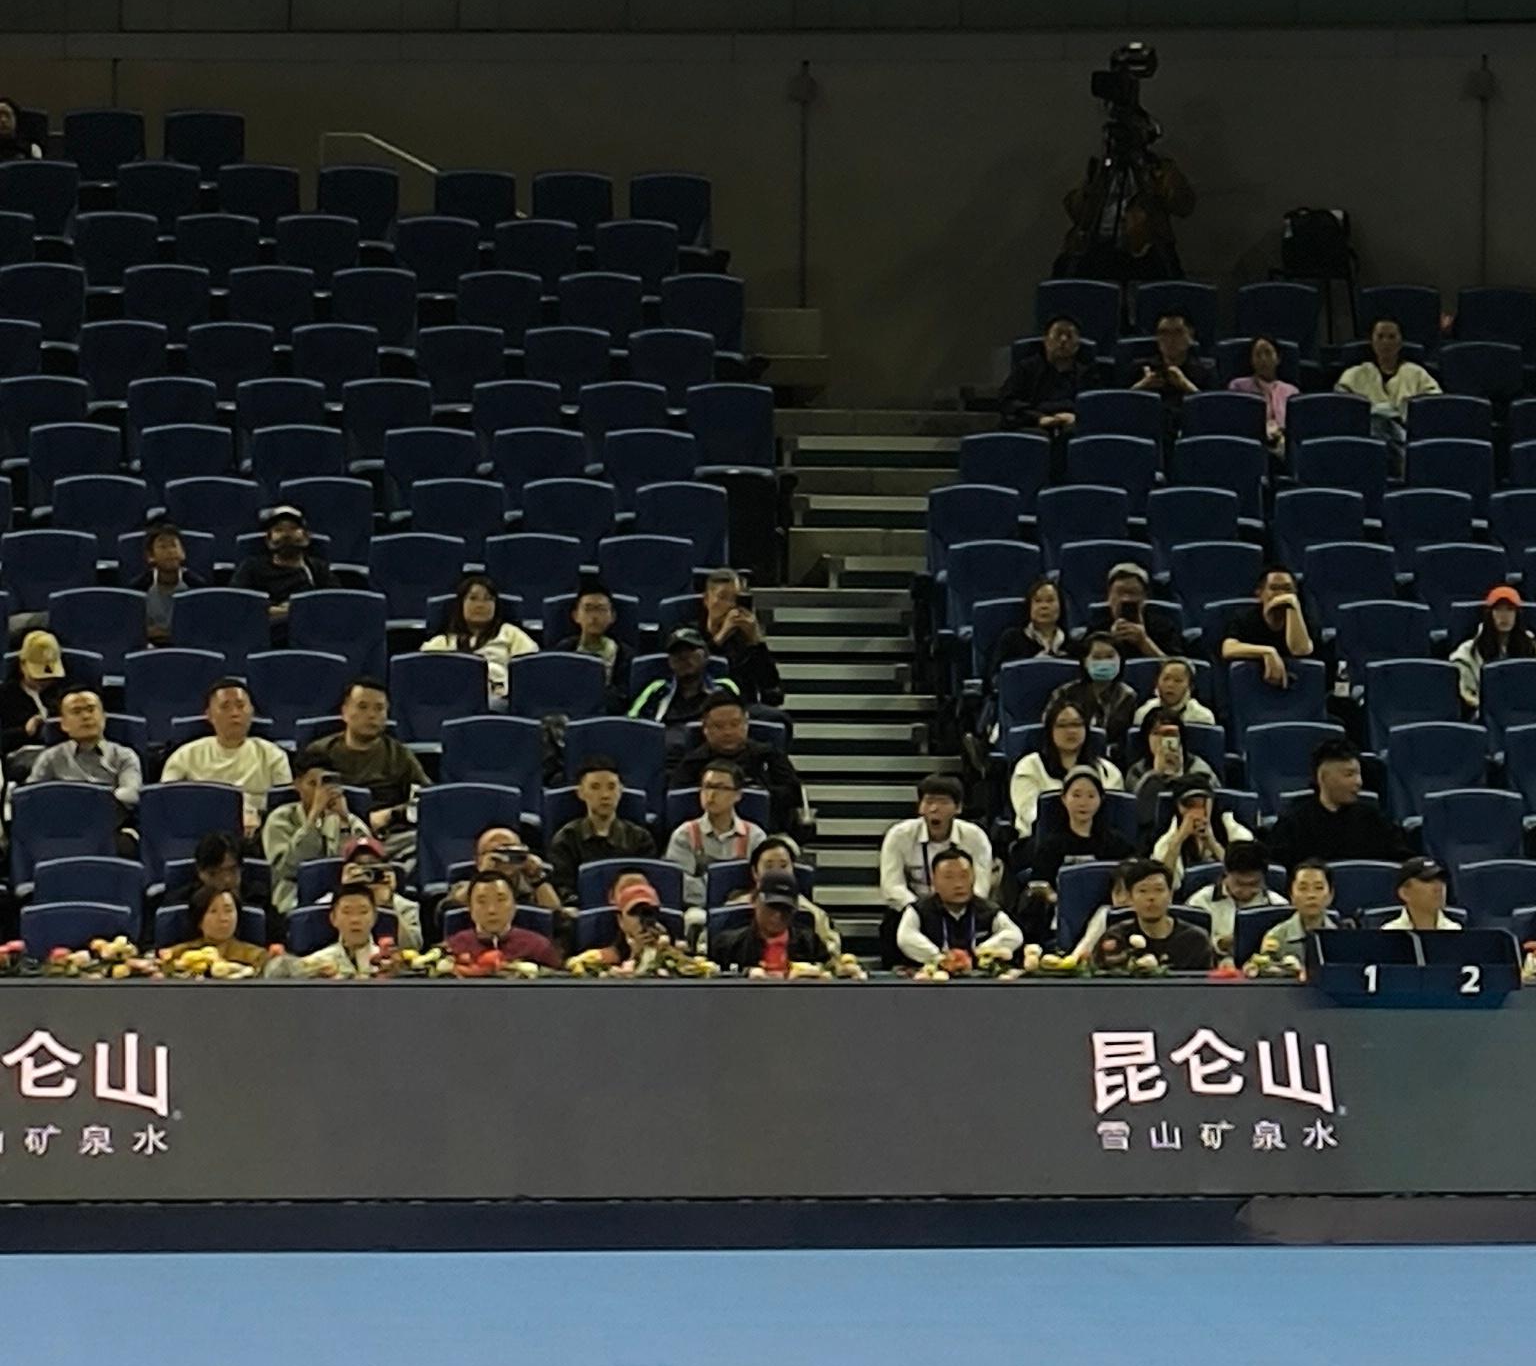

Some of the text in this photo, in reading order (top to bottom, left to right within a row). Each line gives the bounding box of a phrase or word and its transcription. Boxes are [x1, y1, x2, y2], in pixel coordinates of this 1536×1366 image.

[1363, 965, 1377, 993] 1
[1460, 965, 1481, 994] 2
[2, 1029, 169, 1118] 仑山
[1091, 1028, 1335, 1115] 昆仑山
[0, 1124, 169, 1155] 矿泉水
[1096, 1119, 1339, 1151] 雪山矿泉水
